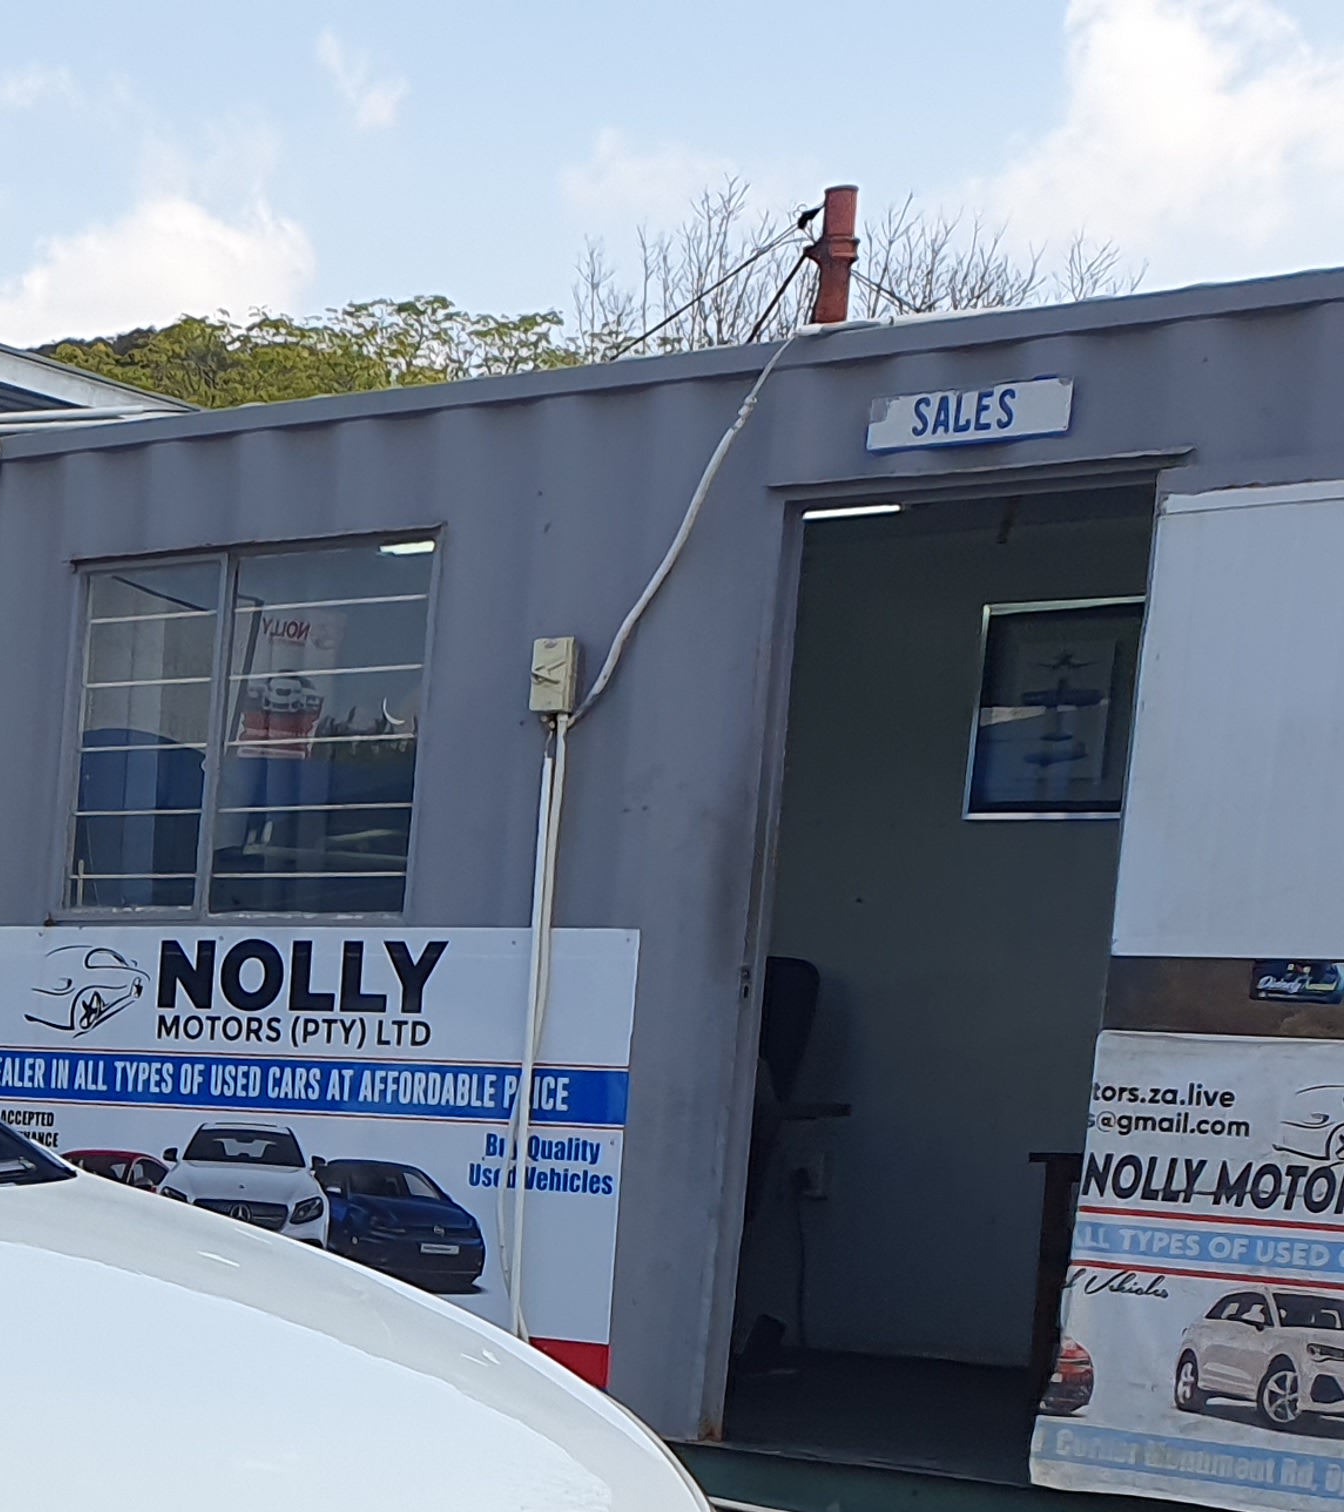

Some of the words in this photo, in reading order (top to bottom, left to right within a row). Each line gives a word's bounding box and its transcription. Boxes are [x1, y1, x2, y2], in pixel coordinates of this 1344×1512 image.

[912, 388, 1016, 437] SALES
[156, 938, 450, 1014] NOLLY
[156, 1014, 282, 1043] MOTORS
[291, 1016, 366, 1049] (PTY)
[376, 1020, 431, 1046] LTD
[50, 1058, 70, 1089] IN
[74, 1060, 108, 1091] ALL
[113, 1061, 174, 1093] TYPES
[179, 1063, 205, 1095] OF
[211, 1064, 261, 1098] USED
[267, 1066, 321, 1100] CARS
[326, 1069, 354, 1101] AT
[358, 1070, 497, 1108] AFFORDABLE
[502, 1075, 570, 1112] PICE
[528, 1135, 601, 1165] Quality
[525, 1166, 614, 1195] Vehicles
[1081, 1152, 1208, 1203] NOLLY
[1212, 1160, 1344, 1215] MOTO
[1119, 1228, 1201, 1257] TYPES
[1208, 1235, 1250, 1261] OF
[1255, 1240, 1331, 1267] USED
